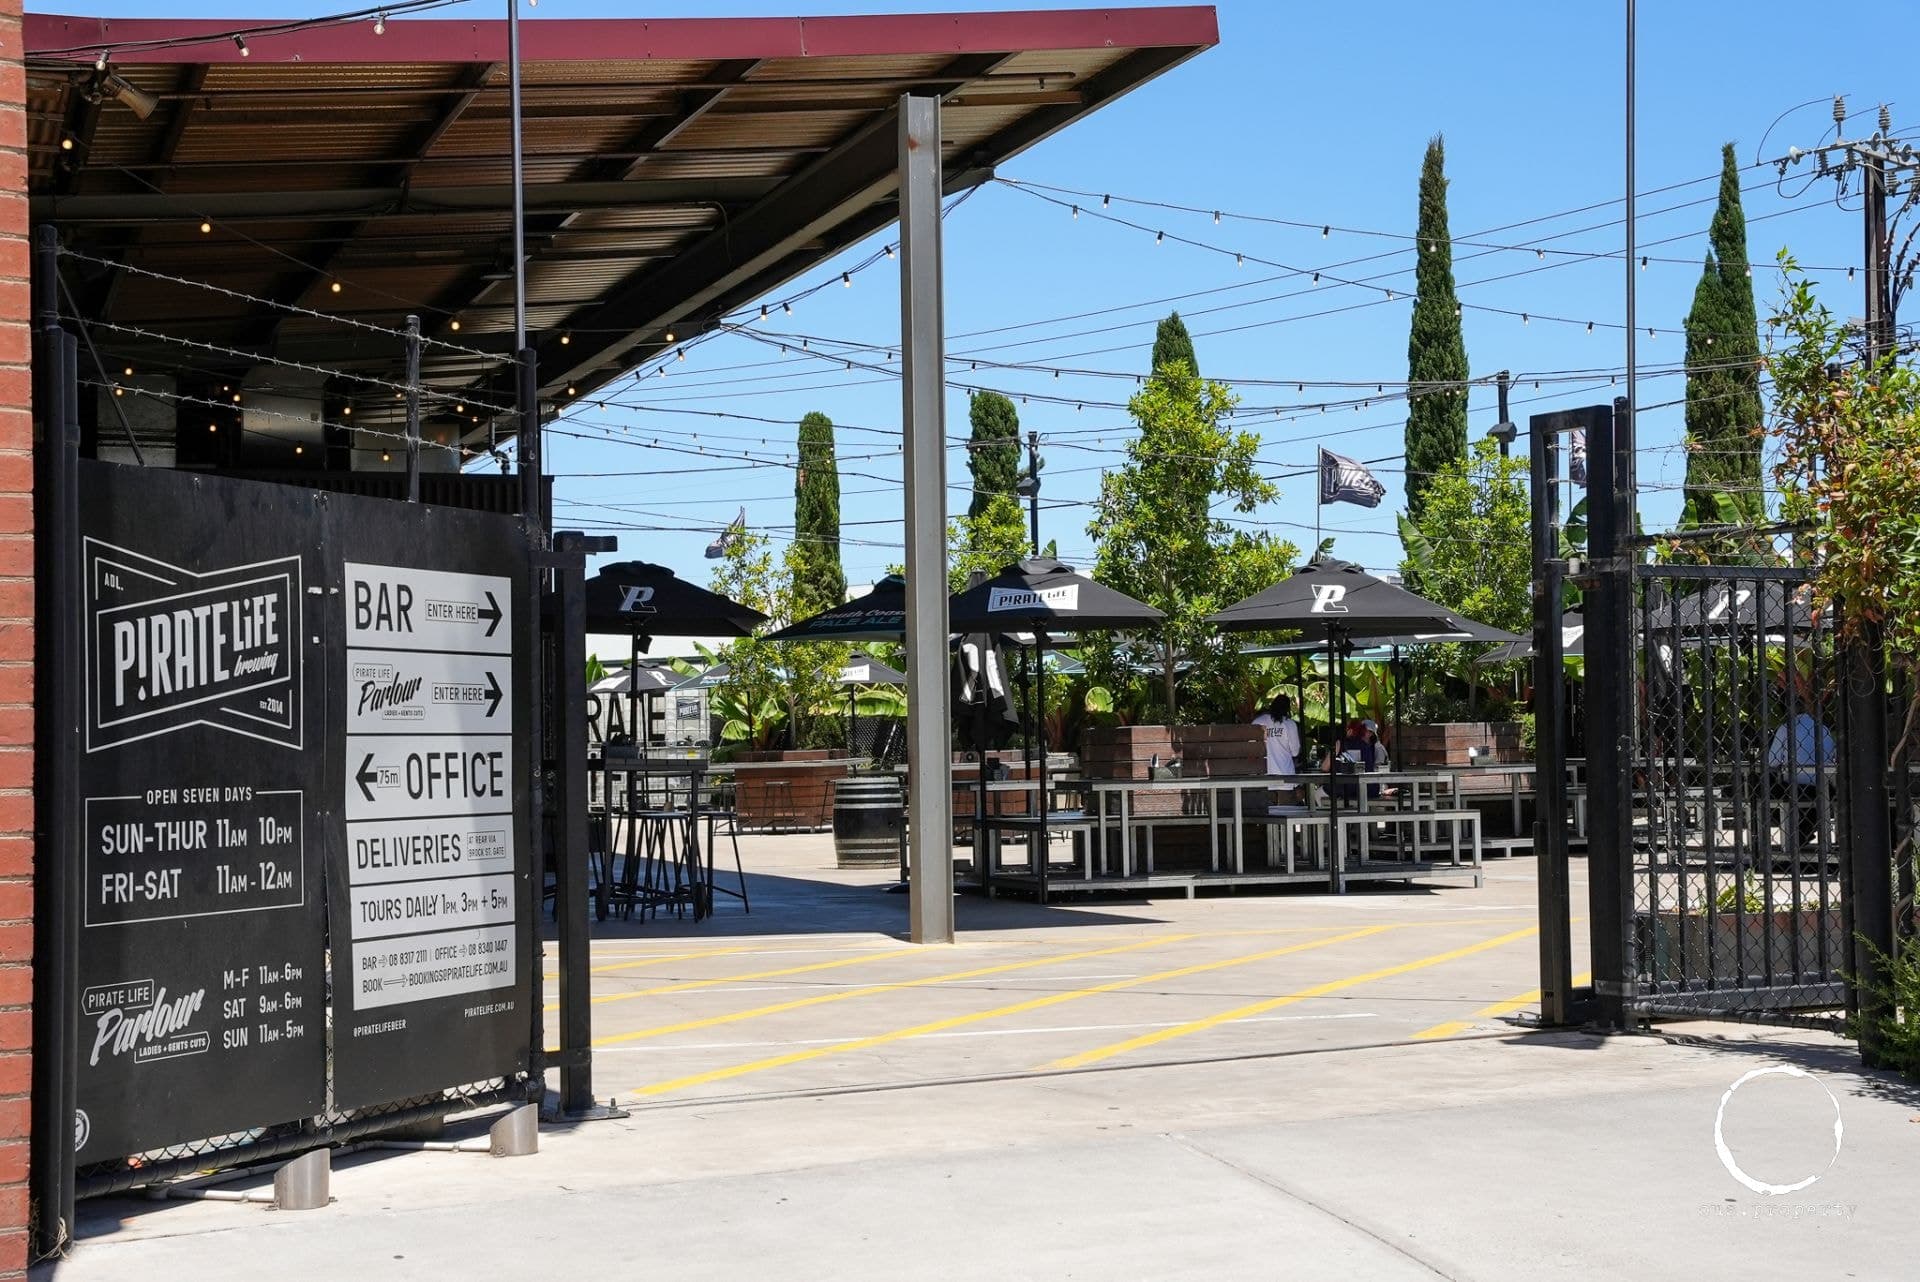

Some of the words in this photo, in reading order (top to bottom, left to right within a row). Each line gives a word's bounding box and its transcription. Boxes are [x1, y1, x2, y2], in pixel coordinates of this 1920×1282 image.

[354, 580, 414, 633] BAR
[427, 603, 454, 620] ENTER
[455, 604, 477, 621] HERE
[861, 615, 903, 625] ALE
[113, 602, 230, 707] PIRATE
[234, 651, 279, 677] brewing
[355, 667, 376, 678] PIRATE
[378, 668, 391, 679] LIFE
[434, 686, 460, 701] ENTER
[462, 686, 483, 702] HERE
[267, 697, 283, 715] 2014
[379, 769, 399, 785] 75m
[405, 751, 504, 800] OFFICE
[146, 789, 178, 805] OPEN
[183, 787, 220, 804] SEVEN
[225, 786, 253, 802] DAYS
[101, 819, 207, 855] SUN-THUR
[216, 818, 248, 848] 11AM
[258, 816, 293, 846] 10PM
[356, 833, 462, 870] DELIVERIES
[102, 868, 182, 905] FRI-SAT
[216, 864, 248, 895] 11AM
[259, 860, 293, 891] 12AM
[360, 898, 402, 923] TOURS
[406, 894, 438, 918] DAILY
[461, 891, 478, 913] 3PM
[491, 888, 508, 910] 5PM
[362, 956, 377, 971] BAR
[388, 953, 398, 967] 08
[399, 951, 415, 965] 8317
[434, 945, 457, 960] OFFICE
[467, 943, 477, 956] 08
[223, 968, 250, 991] M-F
[362, 978, 383, 994] BOOK
[88, 989, 125, 1009] PIRATE
[128, 986, 150, 1004] LIFE
[223, 997, 247, 1020] SAT
[464, 1001, 515, 1018] PIRATELIFE.COM.AU
[89, 986, 205, 1067] Parlour
[223, 1026, 248, 1049] SUN
[139, 1044, 162, 1058] LADIES
[168, 1041, 189, 1053] GENTS
[190, 1037, 206, 1049] CUTS
